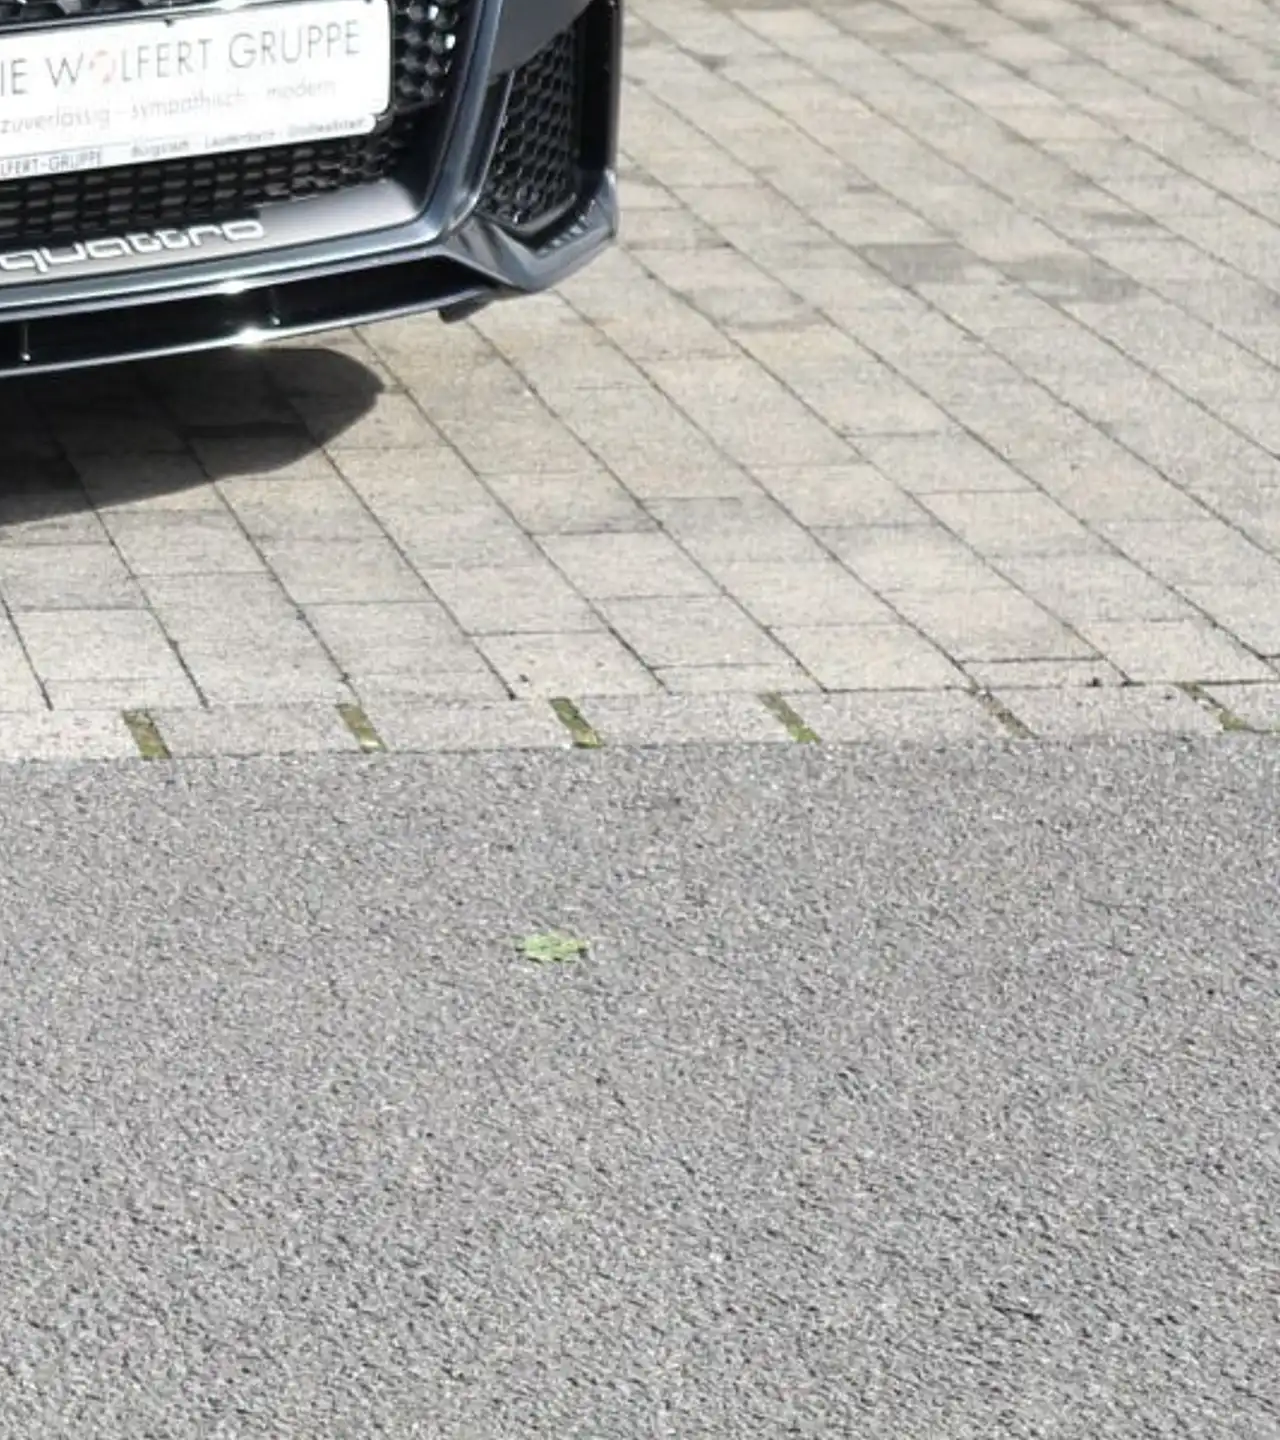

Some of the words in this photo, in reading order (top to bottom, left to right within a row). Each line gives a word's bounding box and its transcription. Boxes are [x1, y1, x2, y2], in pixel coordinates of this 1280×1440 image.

[45, 38, 212, 89] WOLFERT
[228, 19, 361, 69] GRUPPE
[267, 76, 337, 101] modern
